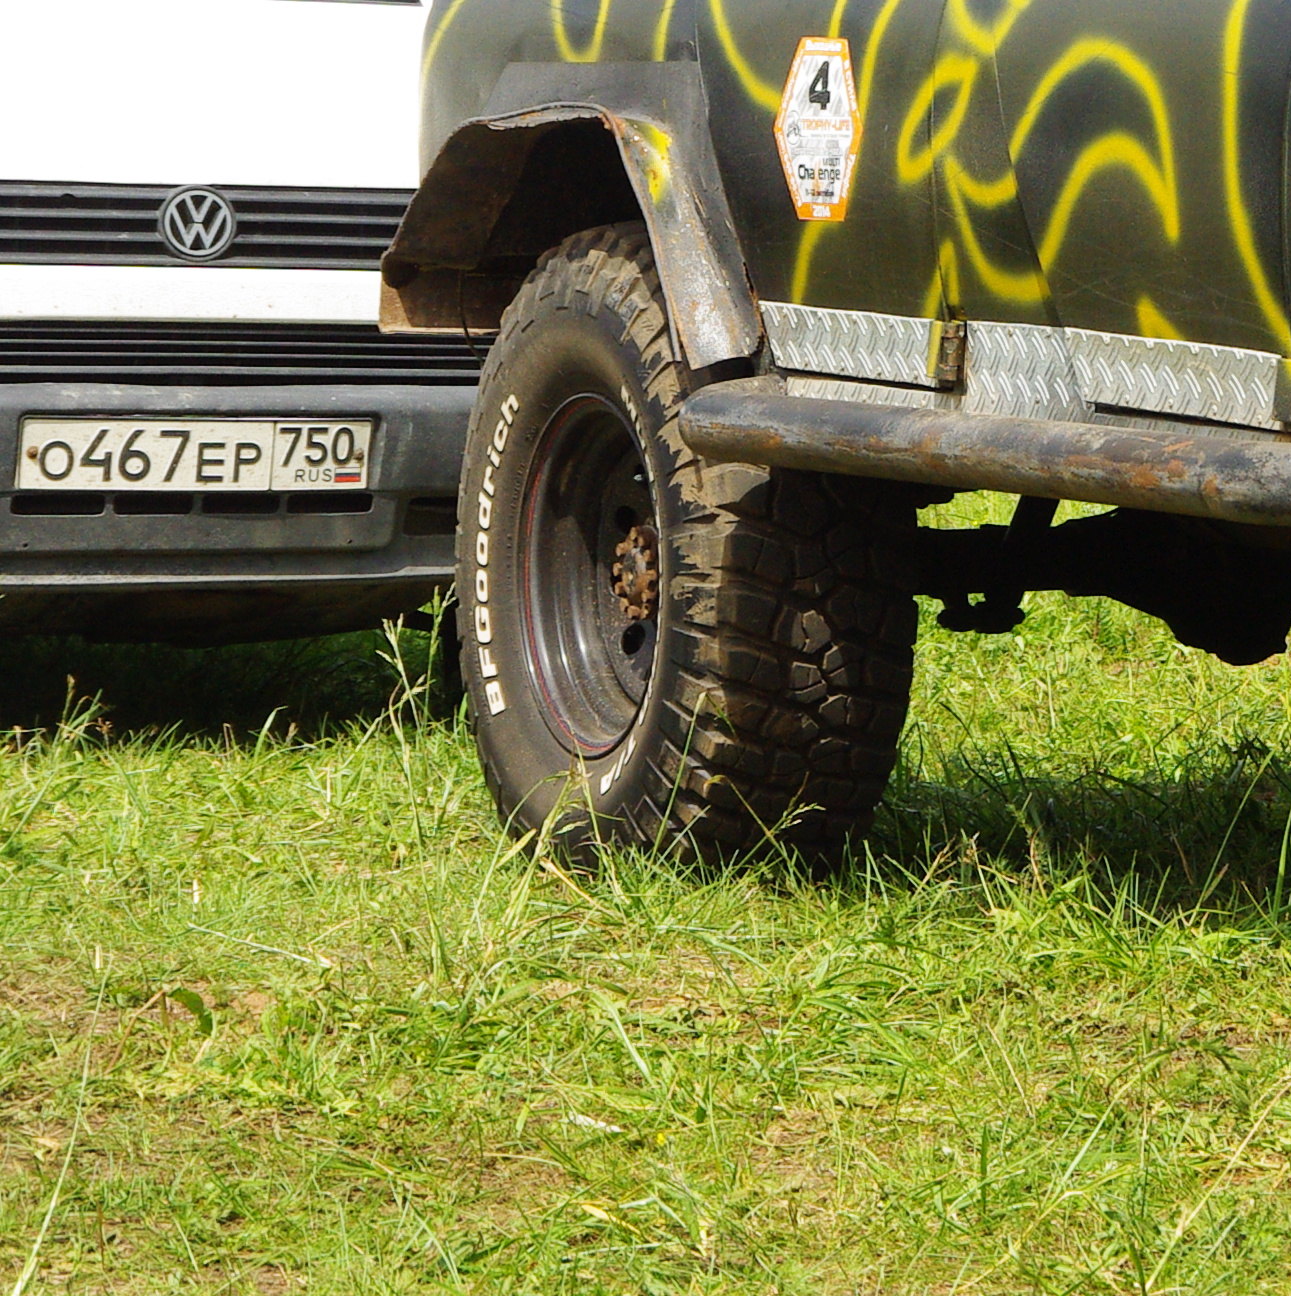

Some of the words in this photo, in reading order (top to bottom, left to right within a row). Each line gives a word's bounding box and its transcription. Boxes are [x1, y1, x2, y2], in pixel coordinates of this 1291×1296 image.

[809, 60, 830, 110] 4
[802, 119, 850, 131] TROPHY-LIFE
[798, 164, 840, 184] Challenge
[279, 427, 356, 467] 750
[294, 468, 333, 483] RUS
[474, 394, 520, 716] BFGoodrich
